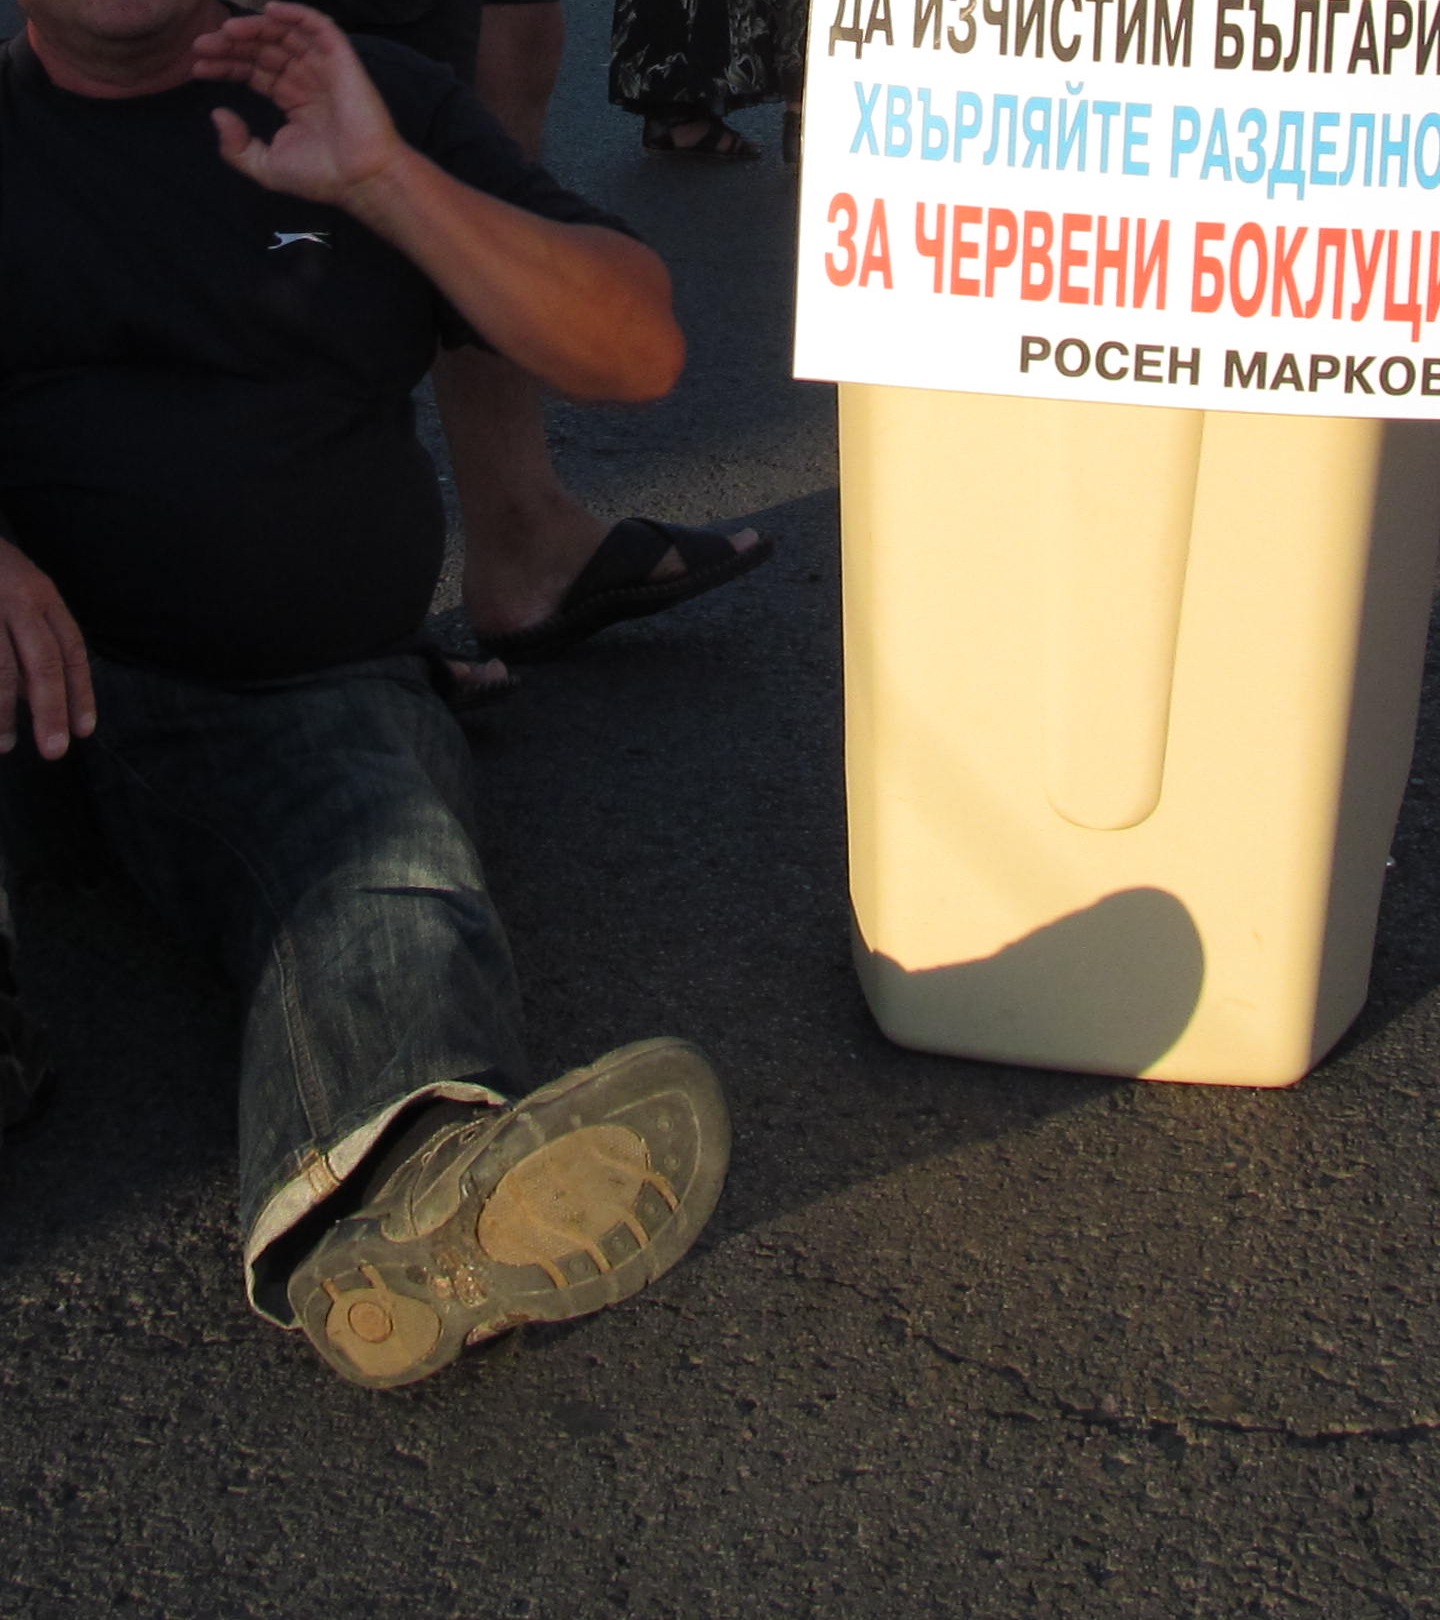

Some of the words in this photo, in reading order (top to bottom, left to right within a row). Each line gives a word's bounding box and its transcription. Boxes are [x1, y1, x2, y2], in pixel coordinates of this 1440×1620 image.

[849, 81, 1151, 177] ХВЪРЛЯЙТЕ
[825, 192, 893, 290] ЗА
[915, 202, 1170, 311] ЧЕРВЕНИ
[1020, 335, 1201, 386] РОСЕН
